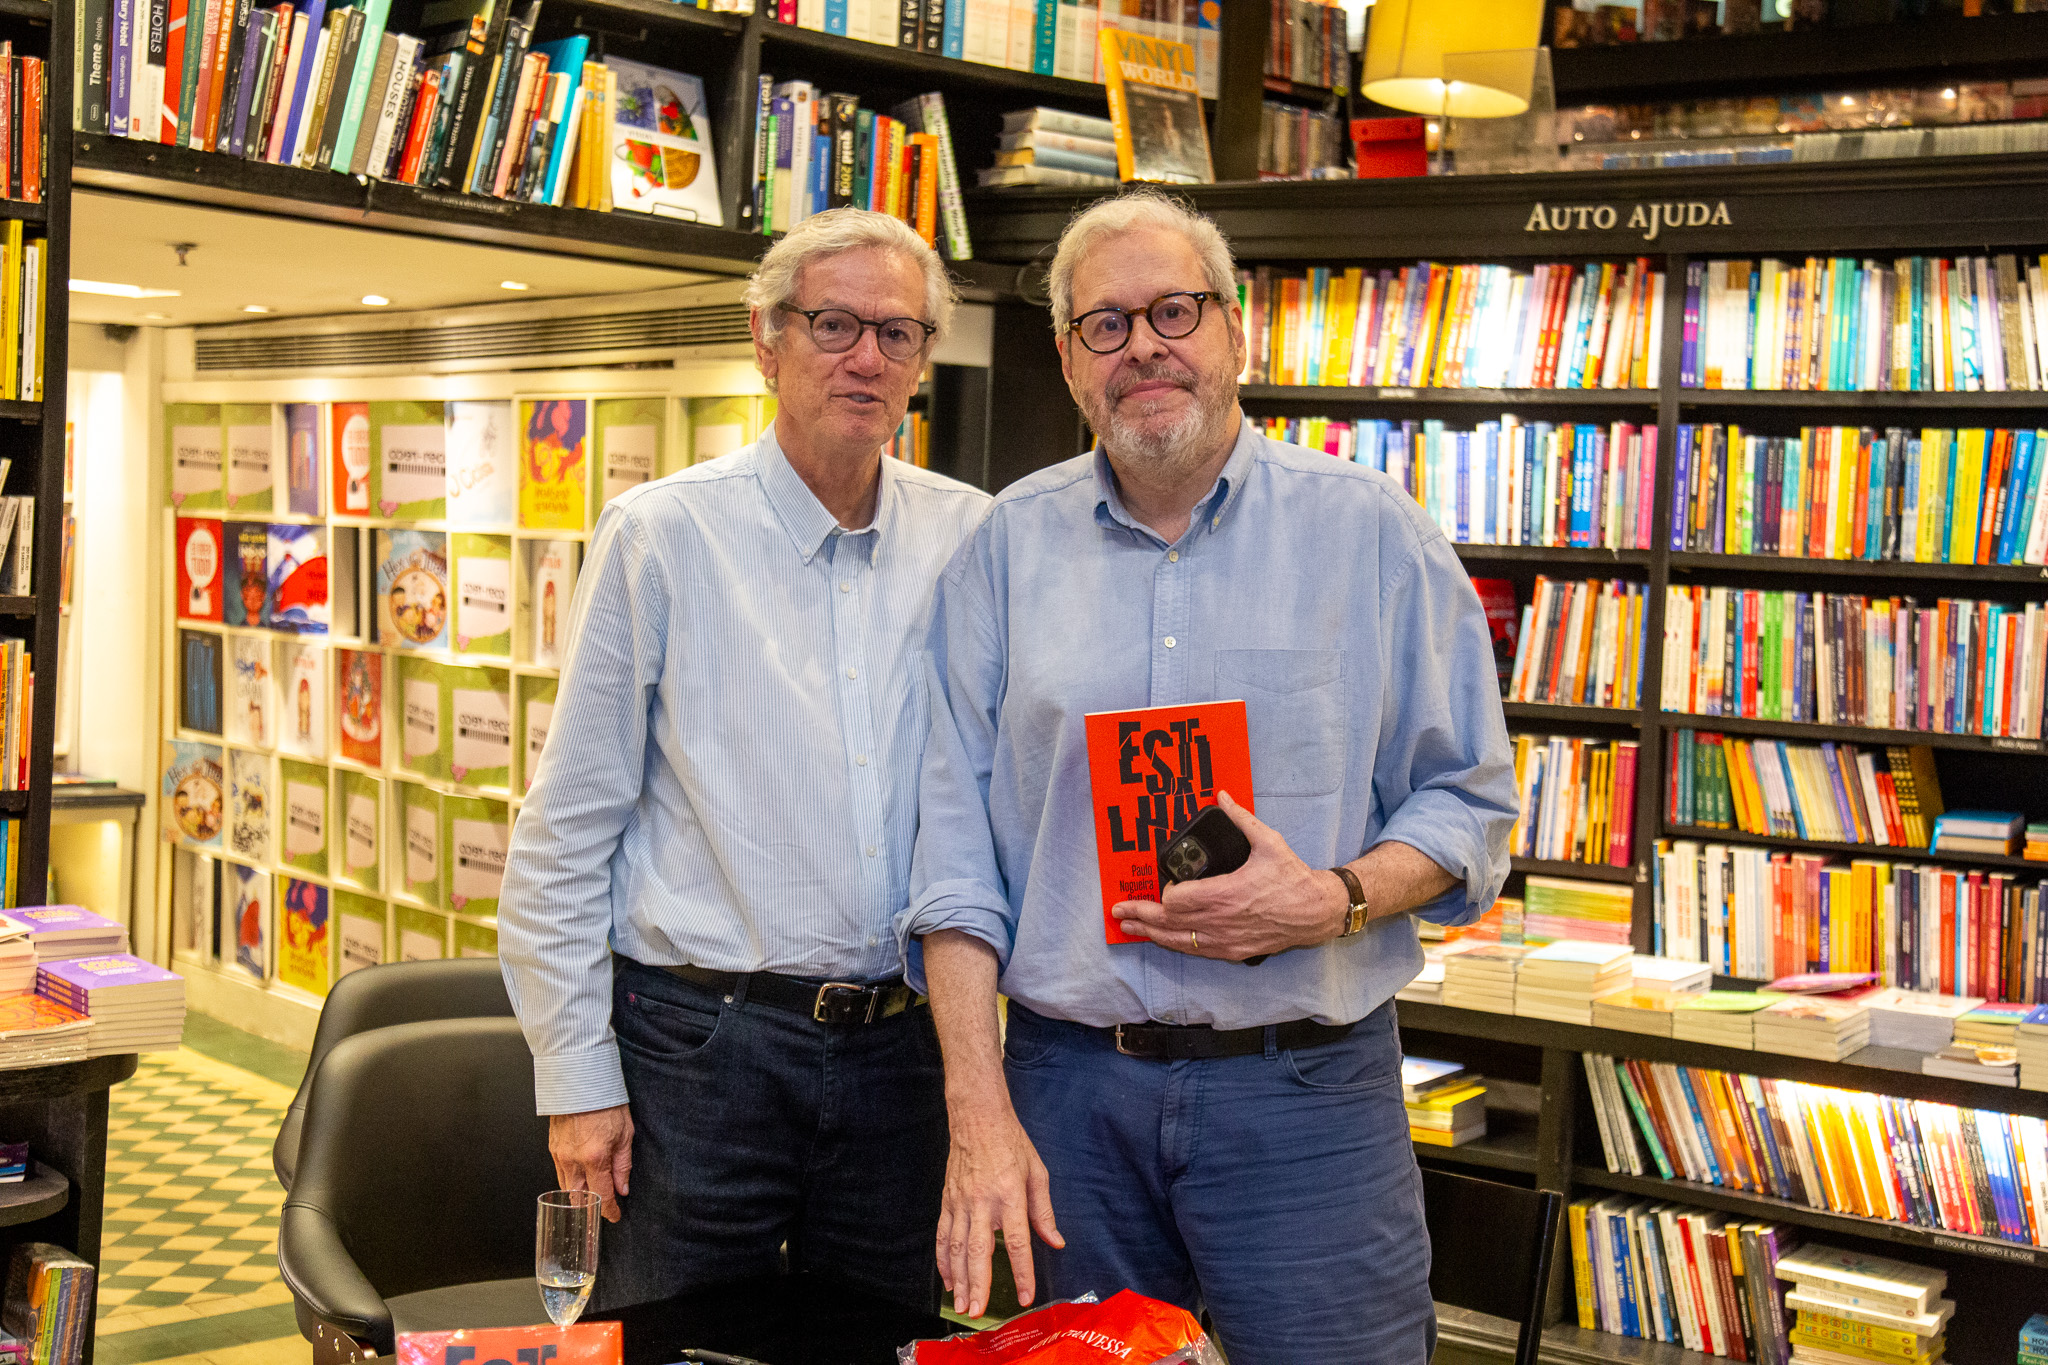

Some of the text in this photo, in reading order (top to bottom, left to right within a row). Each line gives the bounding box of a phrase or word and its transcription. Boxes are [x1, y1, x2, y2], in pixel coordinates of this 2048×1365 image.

[119, 20, 129, 47] Hotel
[150, 4, 164, 54] HOTELS
[221, 18, 230, 32] THE
[334, 18, 344, 35] NEW
[89, 16, 103, 86] Theme Hotels
[218, 33, 228, 52] YEAR
[363, 25, 378, 68] UPGRADE
[1114, 32, 1196, 76] VINYL
[325, 59, 336, 78] CLUB
[360, 70, 369, 82] TO
[496, 49, 513, 98] RESTAURANTS
[1119, 61, 1198, 93] WORLD
[318, 80, 331, 106] DESIGN
[384, 60, 407, 119] HOUSES
[444, 146, 454, 168] SMALL
[449, 122, 460, 146] HOTELS
[457, 92, 467, 113] RURAL
[462, 66, 474, 92] HOTELS
[839, 165, 852, 196] 2006
[948, 208, 960, 237] World
[1524, 201, 1733, 240] AUTO AJUDA
[1132, 864, 1152, 878] Paulo
[1120, 878, 1154, 893] Nogueira
[1935, 1238, 1966, 1248] ESTOQUE
[1978, 1245, 2002, 1256] CORPO
[1800, 1310, 1873, 1337] THE GOOD LIFE
[1800, 1323, 1874, 1348] THE GOOD LIFE
[2032, 1337, 2048, 1347] HO
[2032, 1346, 2048, 1356] HO
